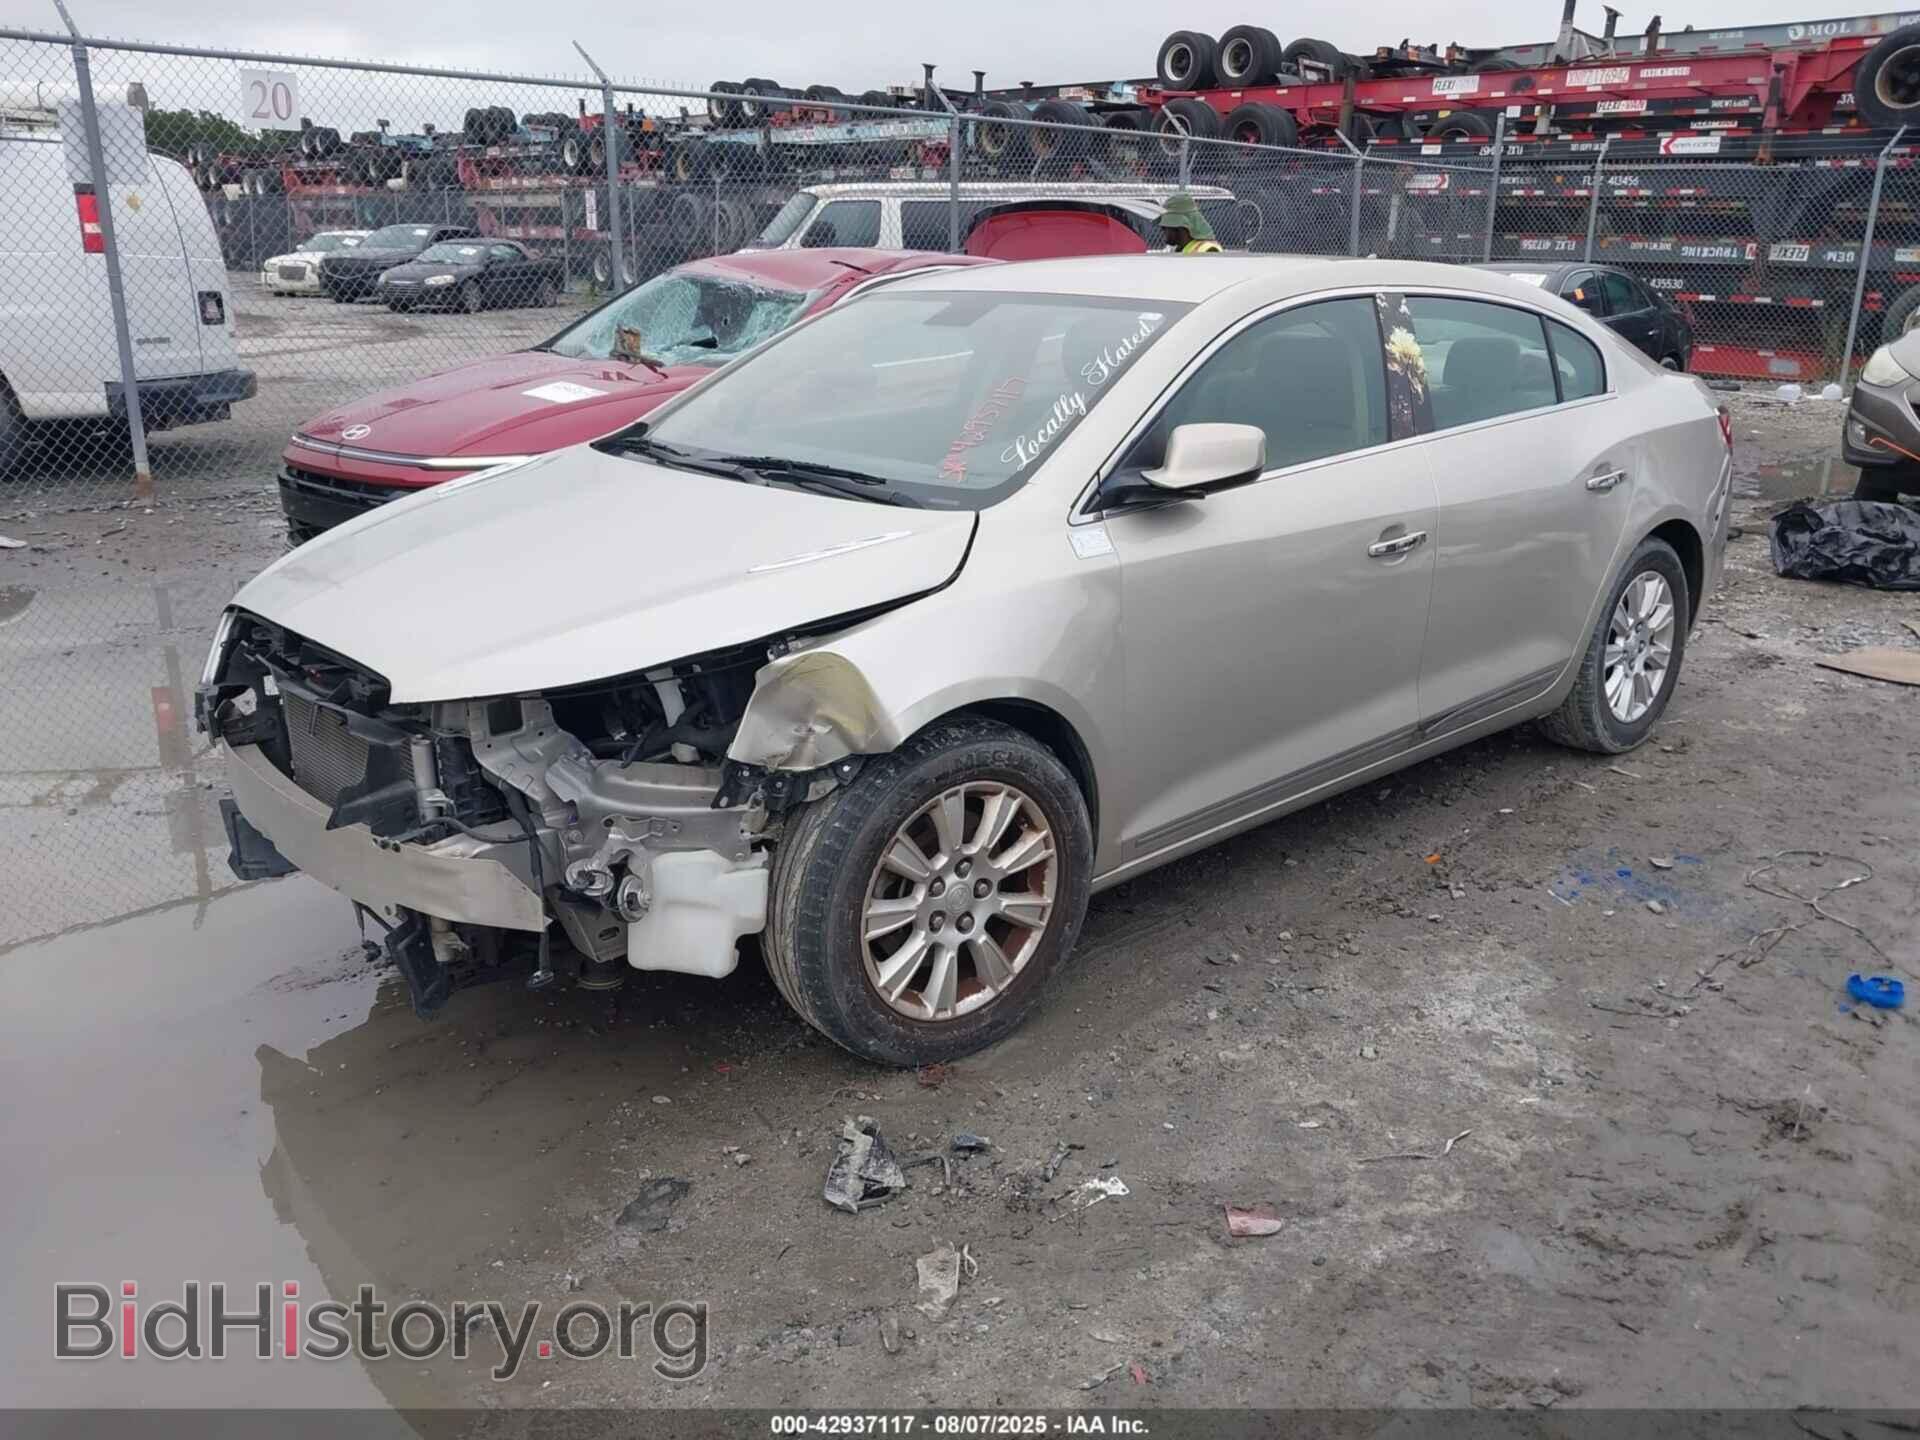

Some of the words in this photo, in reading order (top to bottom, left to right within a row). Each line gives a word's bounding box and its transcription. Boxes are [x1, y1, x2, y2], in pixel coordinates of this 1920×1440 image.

[1807, 22, 1851, 36] MOL
[250, 80, 293, 121] 20
[1681, 246, 1738, 258] TRUCKING
[1000, 391, 1088, 470] Locally
[1081, 319, 1155, 385] Hated
